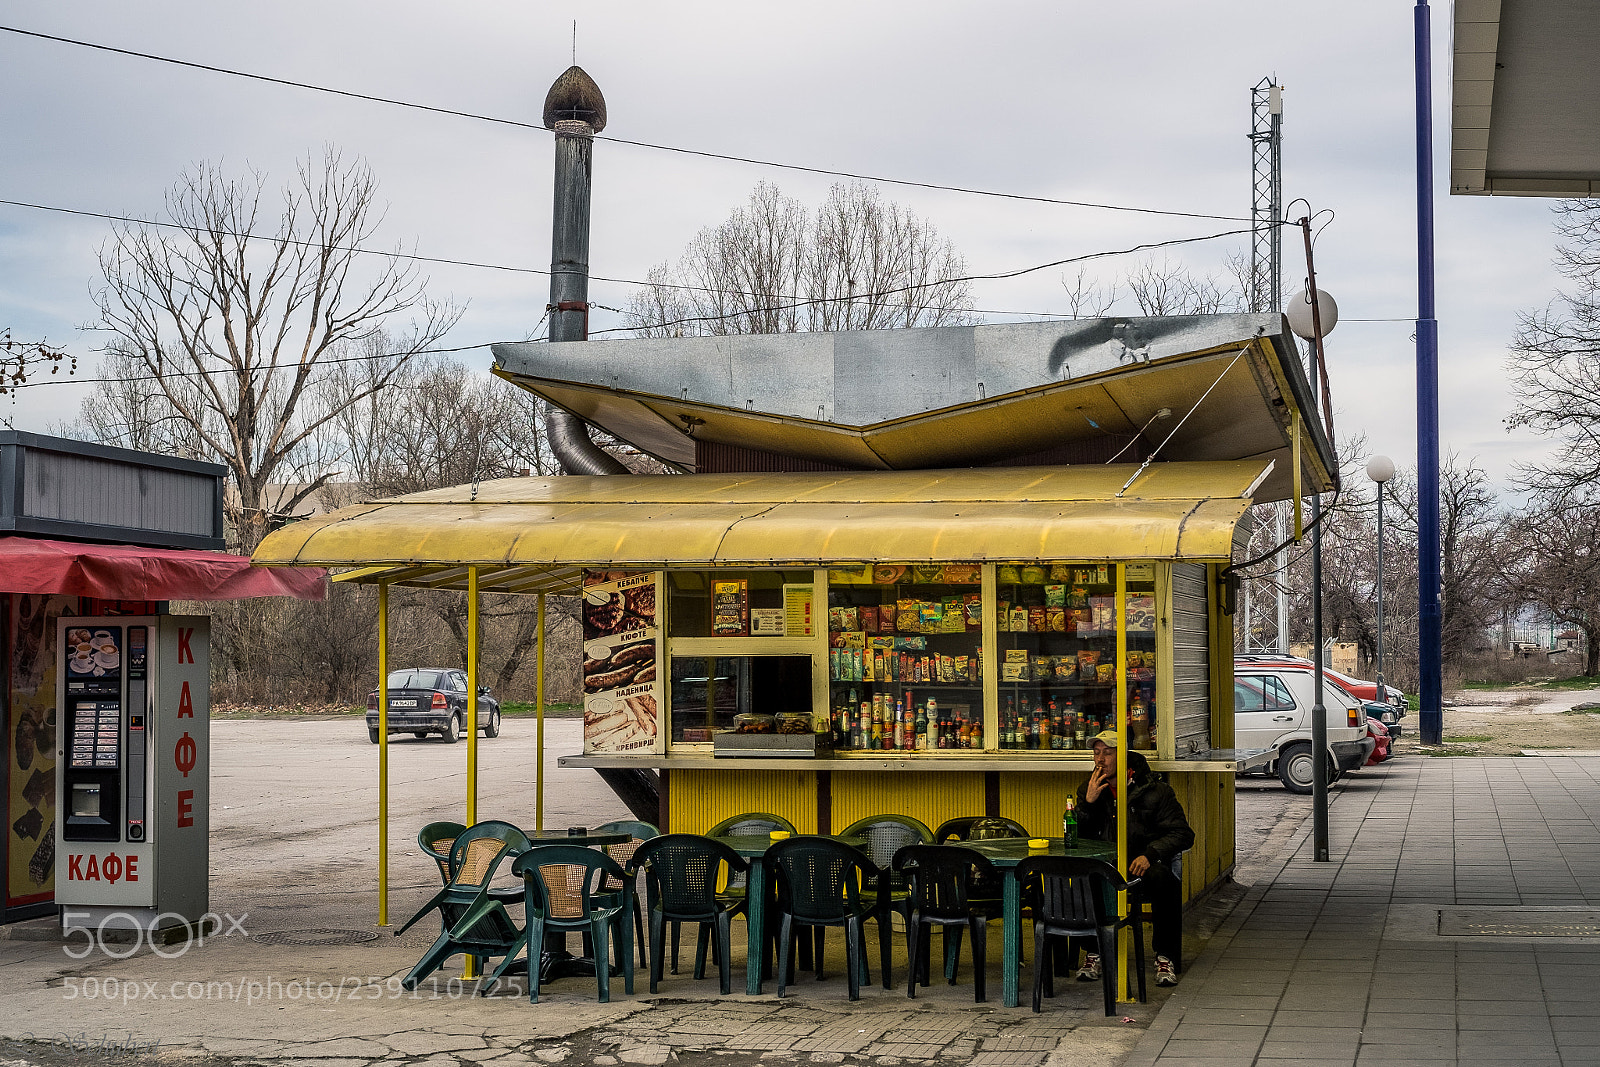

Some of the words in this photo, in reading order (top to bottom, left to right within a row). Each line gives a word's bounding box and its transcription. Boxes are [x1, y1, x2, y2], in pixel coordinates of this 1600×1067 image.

[617, 575, 649, 588] КЕБАПЧЕ
[620, 630, 647, 642] КЮФТЕ
[616, 683, 654, 698] НАДЕНИЦА
[174, 627, 197, 828] КАФЕ
[68, 852, 139, 885] КАФЕ
